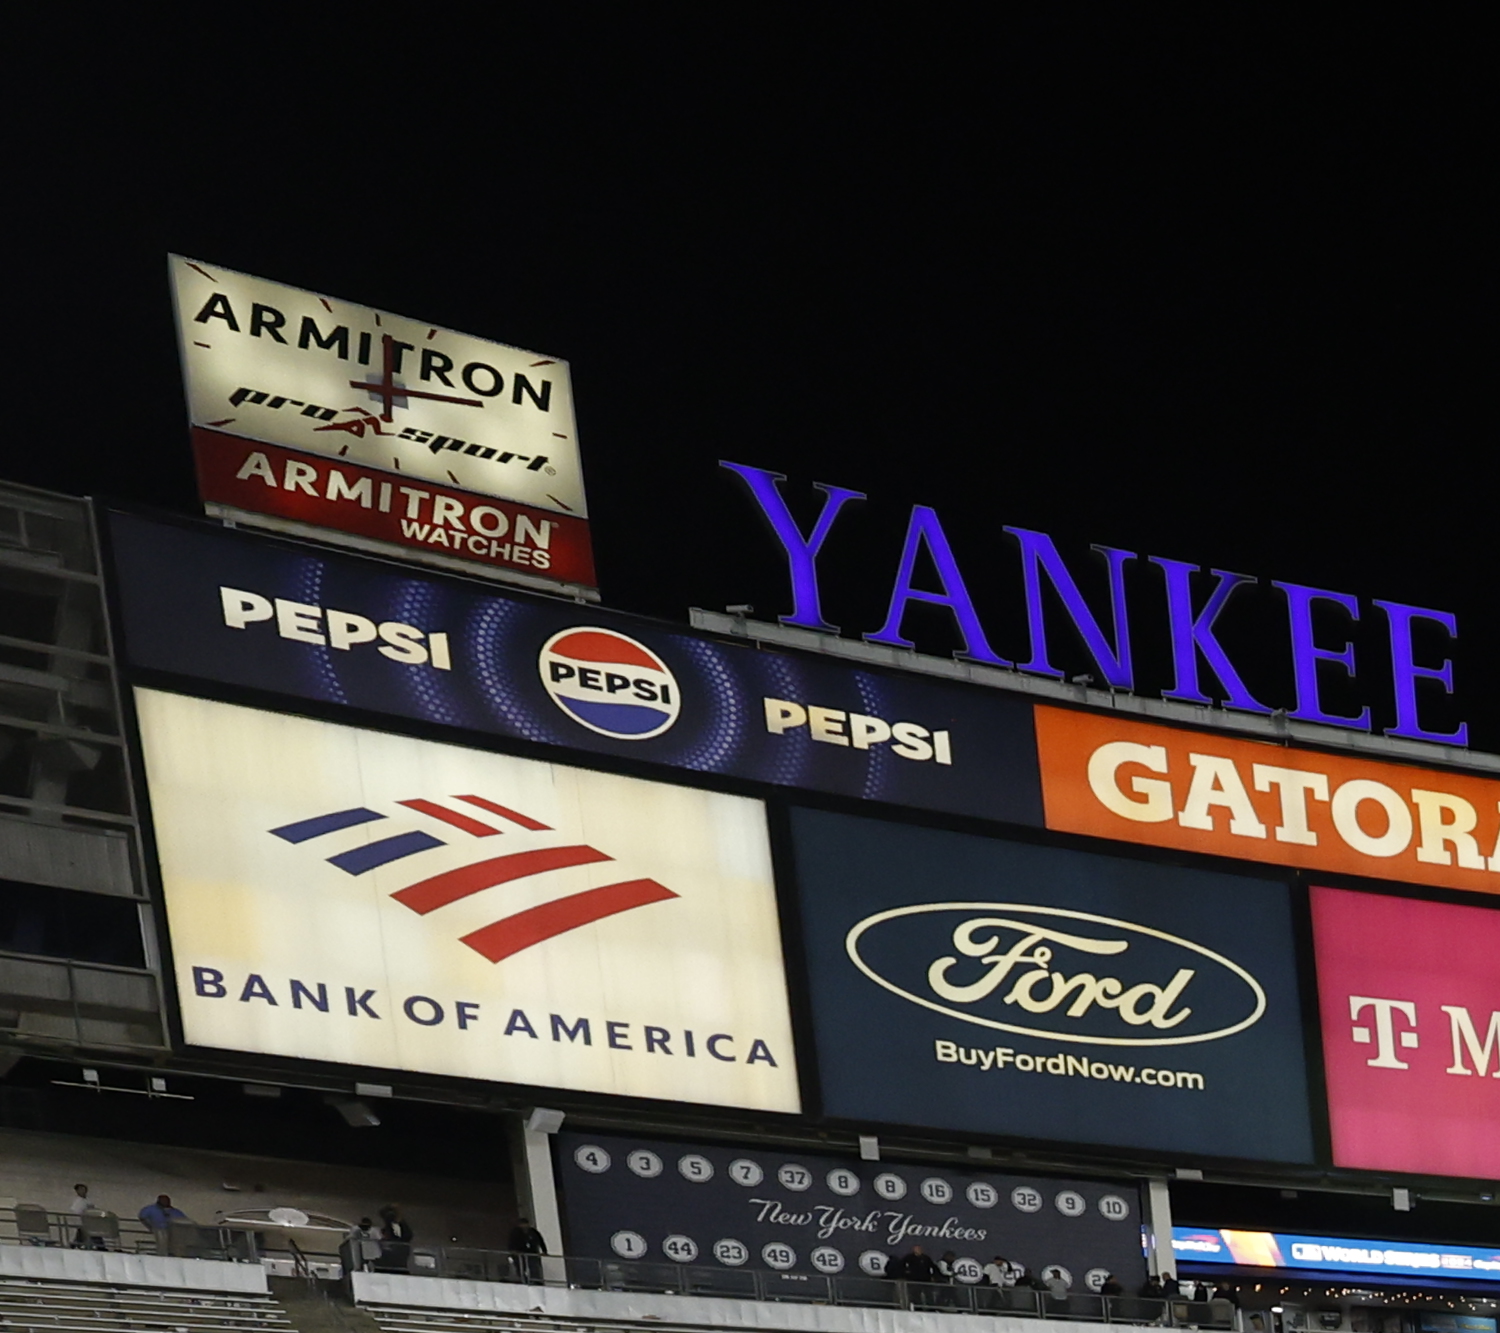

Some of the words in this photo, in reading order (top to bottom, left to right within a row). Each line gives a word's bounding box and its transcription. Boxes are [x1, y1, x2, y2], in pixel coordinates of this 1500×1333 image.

[193, 292, 553, 412] ARMITRON
[227, 386, 340, 422] pro
[396, 428, 550, 475] sport
[236, 452, 552, 550] ARMITRON
[401, 519, 551, 570] WATCHES
[219, 586, 452, 671] PEPSI
[718, 459, 1468, 747] YANKEE
[548, 660, 672, 705] PEPSI
[764, 697, 952, 765] PEPSI
[928, 917, 1196, 1030] Ford
[192, 966, 381, 1020] BANK
[403, 995, 480, 1029] OF
[503, 1009, 779, 1068] AMERICA
[935, 1038, 1204, 1091] BuyFordNow.com
[586, 1152, 598, 1166] 4
[640, 1156, 651, 1170] 3
[690, 1161, 702, 1176] 5
[739, 1165, 751, 1180] 7
[785, 1171, 805, 1185] 37
[837, 1175, 849, 1189] 8
[885, 1180, 896, 1193] 8
[928, 1183, 945, 1197] 16
[973, 1188, 990, 1202] 15
[1017, 1192, 1037, 1206] 32
[1065, 1197, 1075, 1210] 9
[1105, 1201, 1121, 1215] 10
[624, 1237, 633, 1252] 1
[667, 1241, 693, 1255] 44
[719, 1245, 742, 1260] 23
[767, 1249, 789, 1263] 49
[815, 1252, 838, 1267] 42
[871, 1257, 881, 1270] 6
[749, 1199, 812, 1225] New
[814, 1205, 881, 1239] York
[884, 1212, 987, 1245] Yankees
